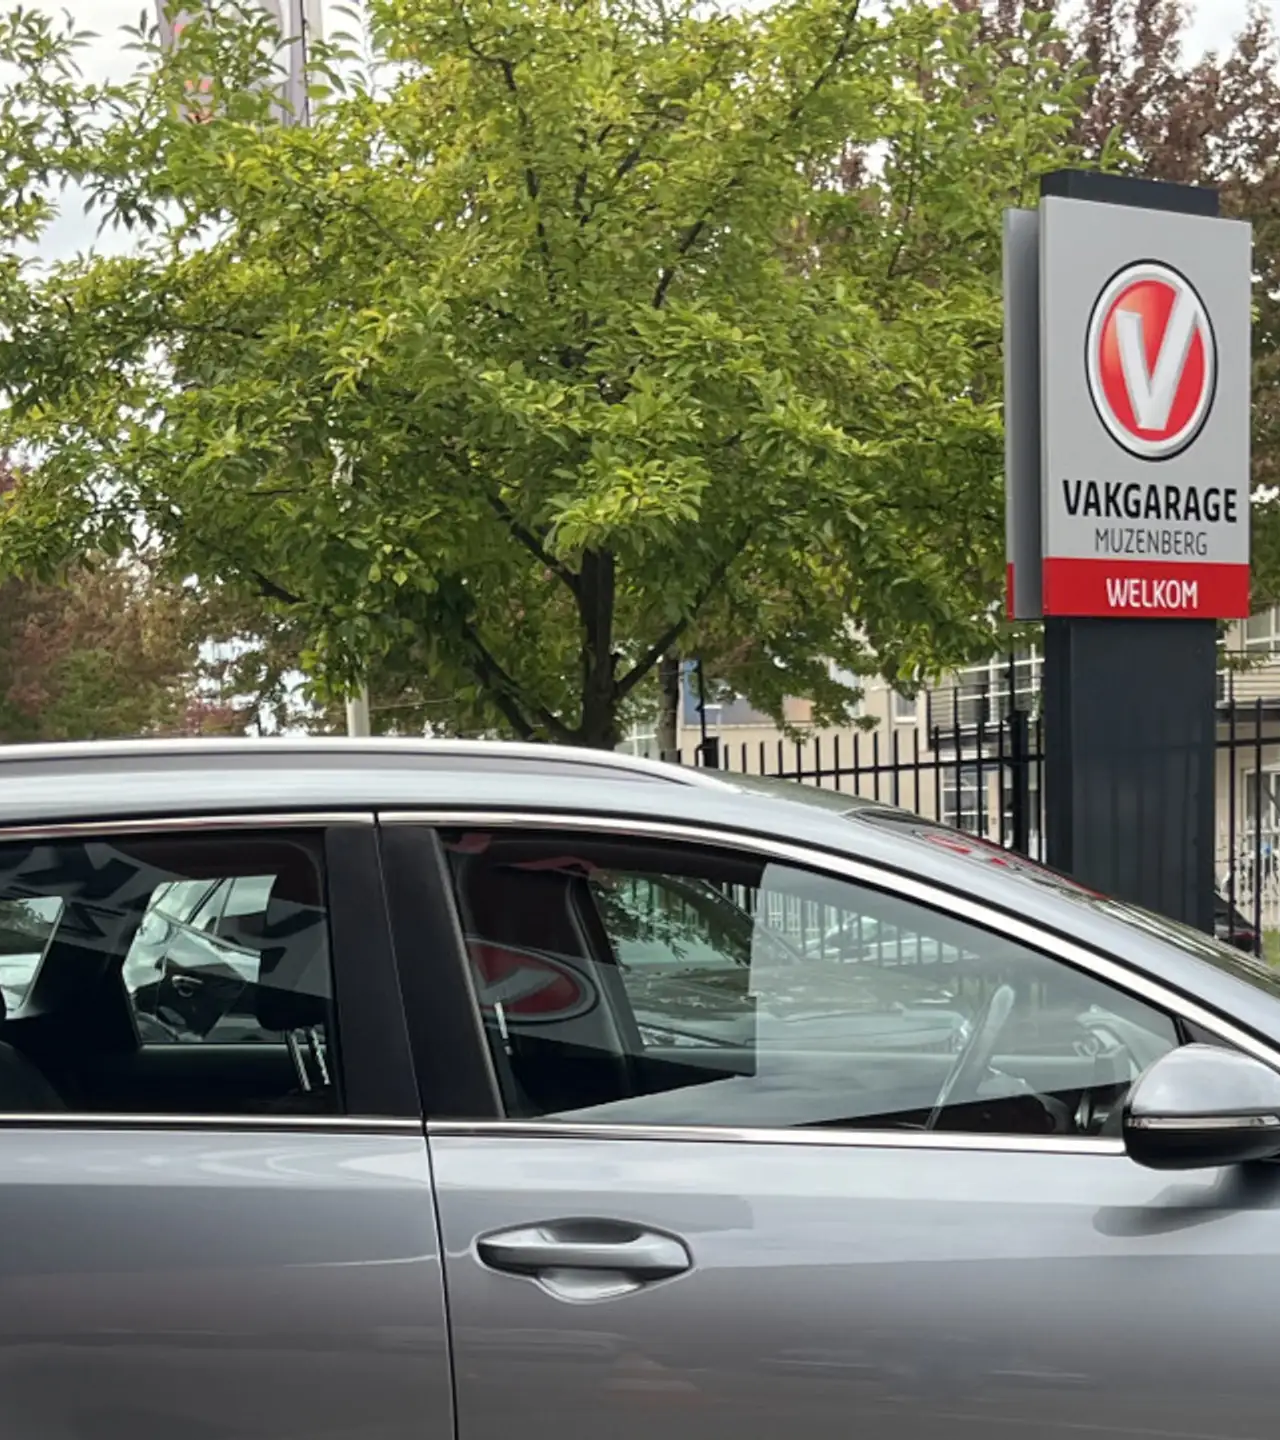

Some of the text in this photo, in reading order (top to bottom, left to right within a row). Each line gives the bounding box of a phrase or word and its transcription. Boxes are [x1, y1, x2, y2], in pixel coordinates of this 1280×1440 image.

[1115, 285, 1202, 432] V
[1061, 479, 1238, 523] VAKGARAGE
[1105, 577, 1198, 609] WELKOM
